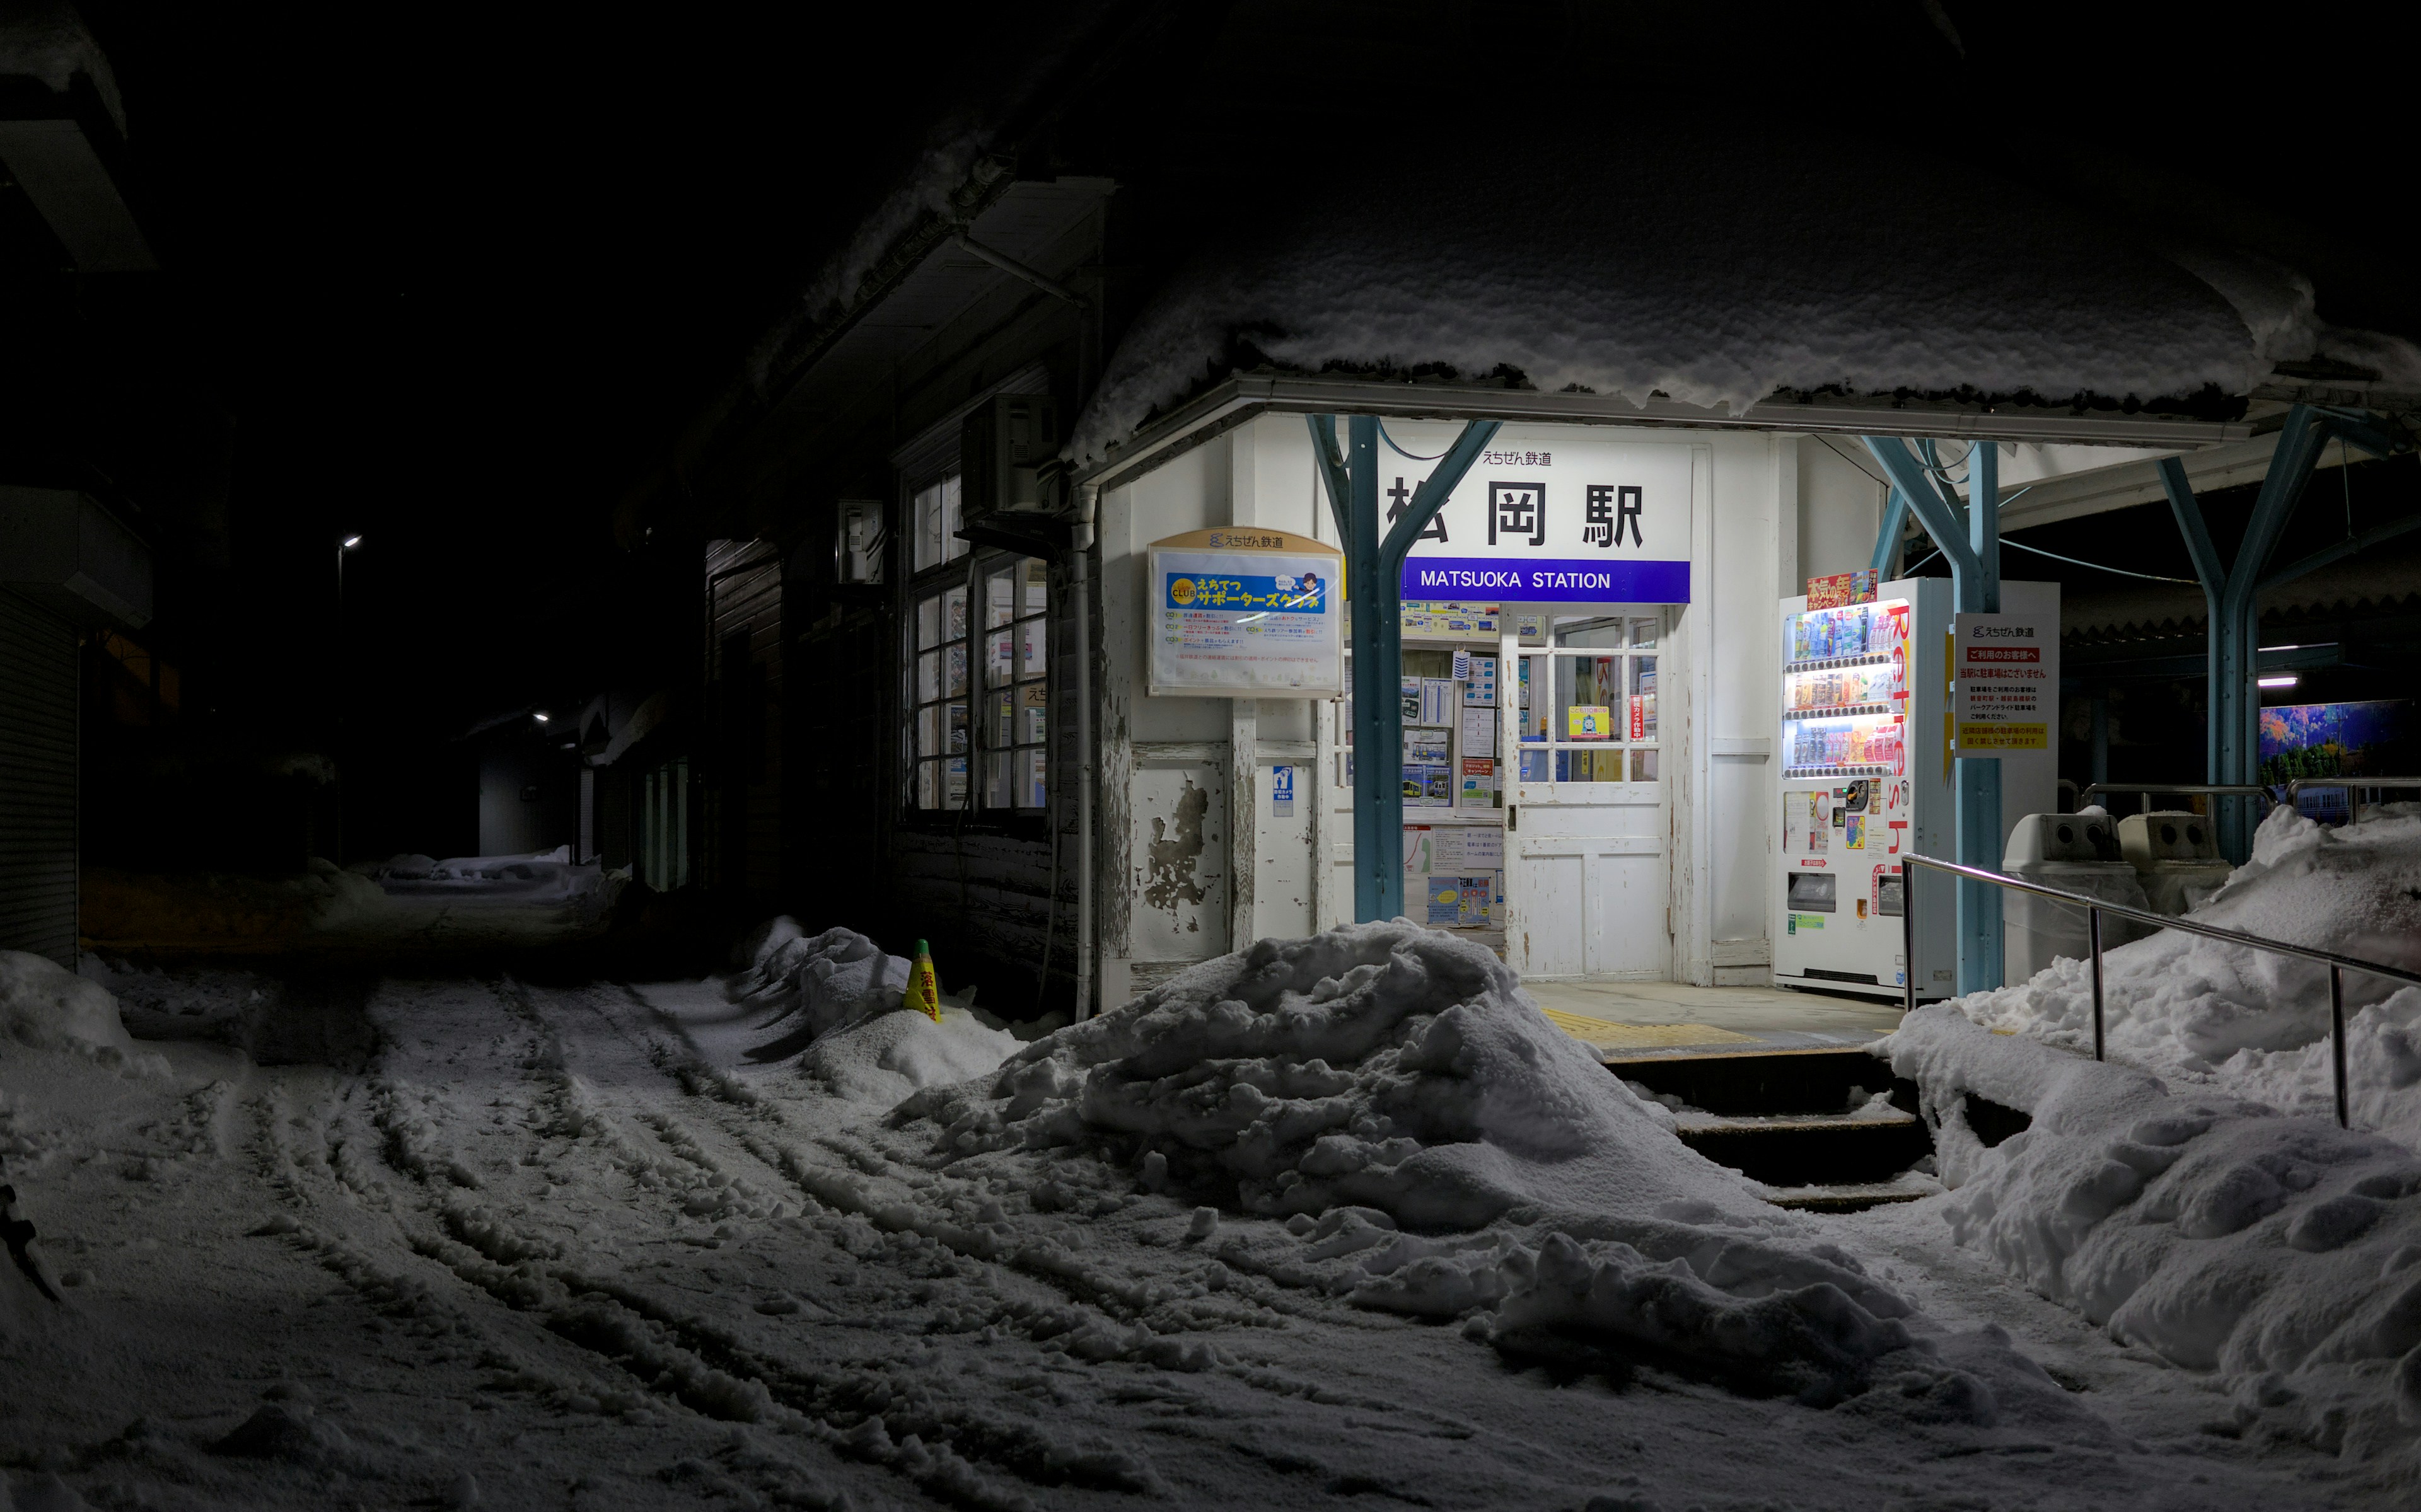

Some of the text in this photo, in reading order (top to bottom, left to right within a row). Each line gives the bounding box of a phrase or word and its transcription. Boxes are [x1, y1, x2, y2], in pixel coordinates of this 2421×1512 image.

[1483, 451, 1552, 466] えちぜん鉄道
[1225, 536, 1284, 548] えちぜん鉄道
[1197, 579, 1241, 591] えちてつ
[1420, 570, 1610, 589] MATSUOKA STATION
[1197, 591, 1320, 608] サポーターズクラブ
[1985, 627, 2035, 638] えちぜん鉄道
[1970, 650, 2036, 660] ご利用のお客様へ
[1960, 668, 2046, 679] 当駅に駐車場はございません
